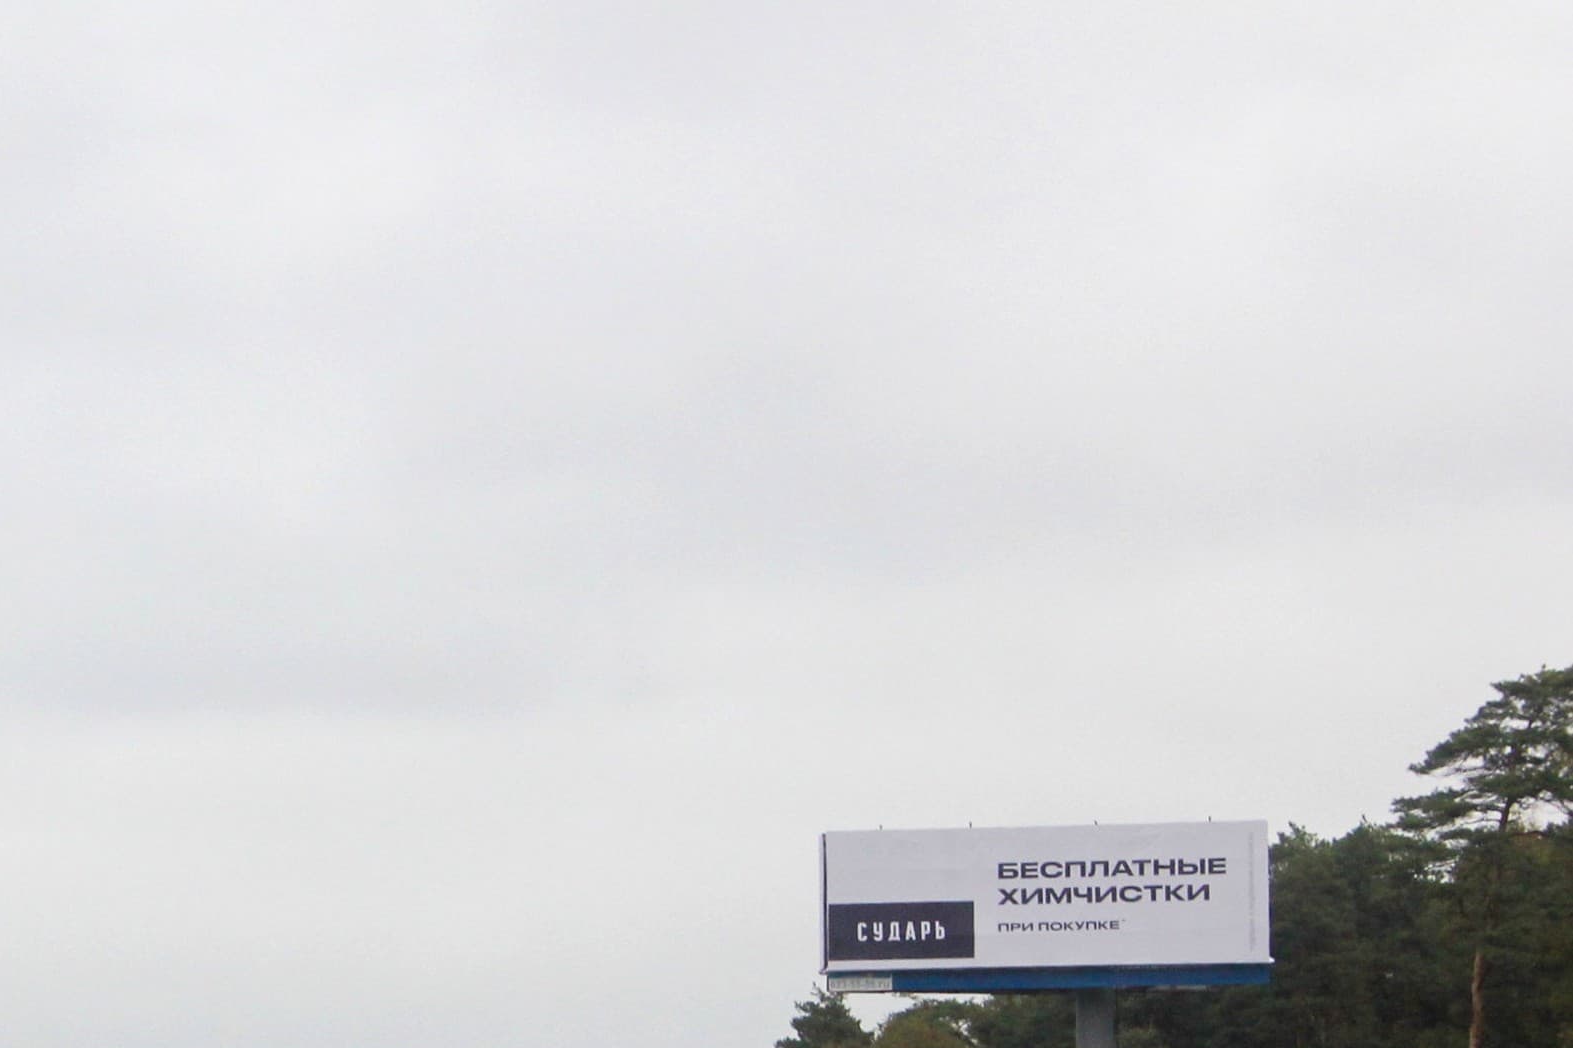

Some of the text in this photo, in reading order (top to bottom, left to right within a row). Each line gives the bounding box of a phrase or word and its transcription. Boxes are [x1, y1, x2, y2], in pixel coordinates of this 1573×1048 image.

[997, 857, 1227, 879] БЕСПЛАТНЫЕ
[997, 884, 1211, 905] ХИМЧИСТКИ
[856, 920, 946, 942] СУДАРЬ
[997, 922, 1034, 932] ПРИ
